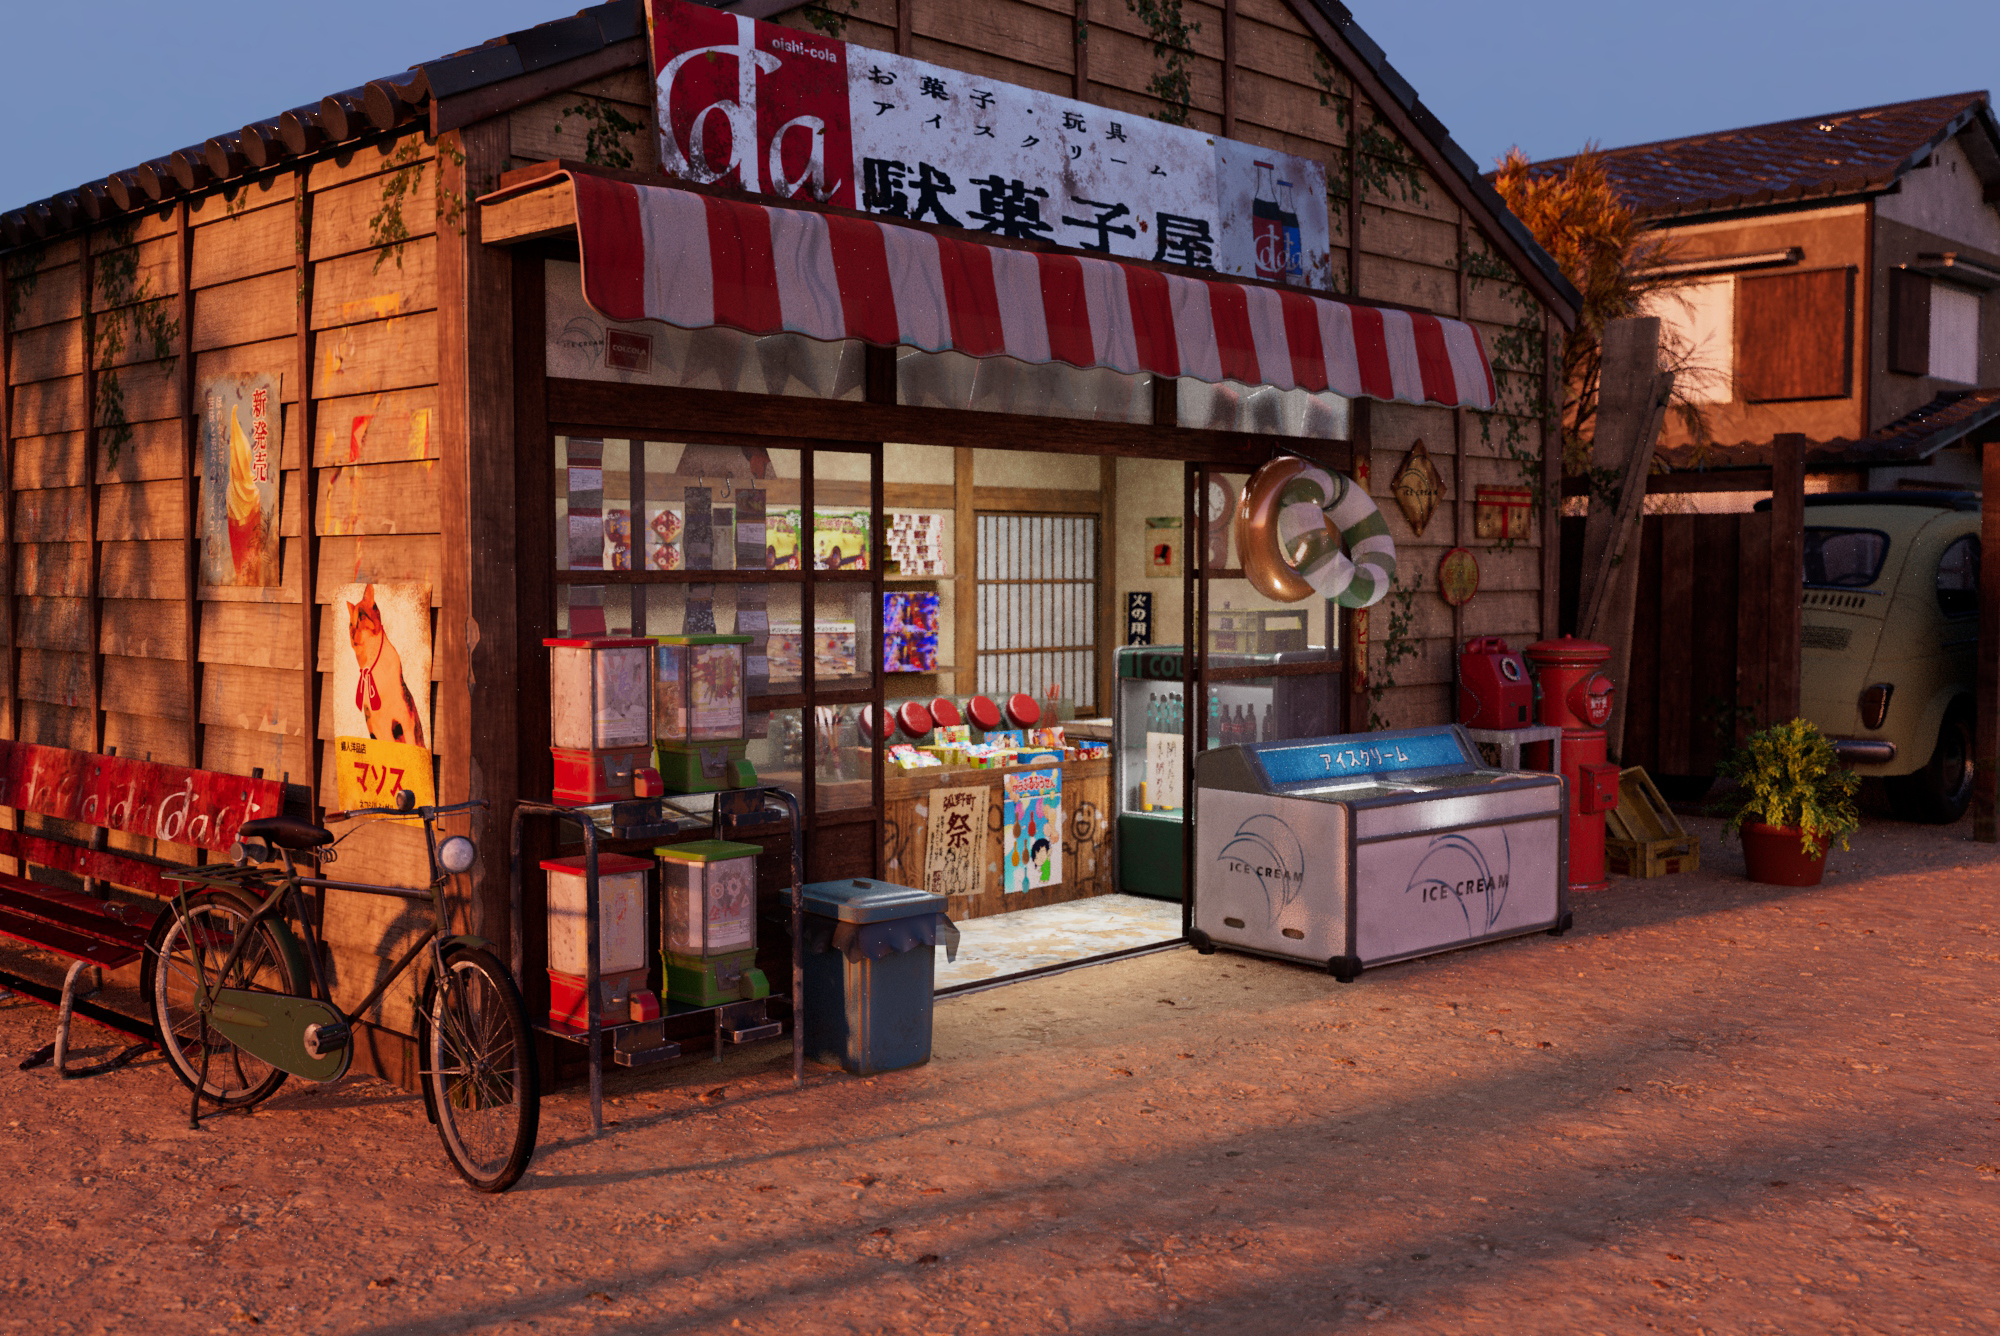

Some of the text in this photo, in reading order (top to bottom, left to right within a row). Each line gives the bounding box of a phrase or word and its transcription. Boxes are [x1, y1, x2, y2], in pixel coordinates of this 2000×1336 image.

[771, 37, 838, 63] oishi-cola
[872, 100, 1168, 177] アイスクリーム
[612, 344, 648, 356] COLCOLA
[252, 387, 268, 484] 新発売
[1319, 745, 1410, 771] アイスクリーム
[353, 761, 406, 797] マソス
[945, 811, 973, 849] 祭
[1229, 861, 1304, 882] ICE CREAM
[1422, 873, 1509, 903] ICE CREAM
